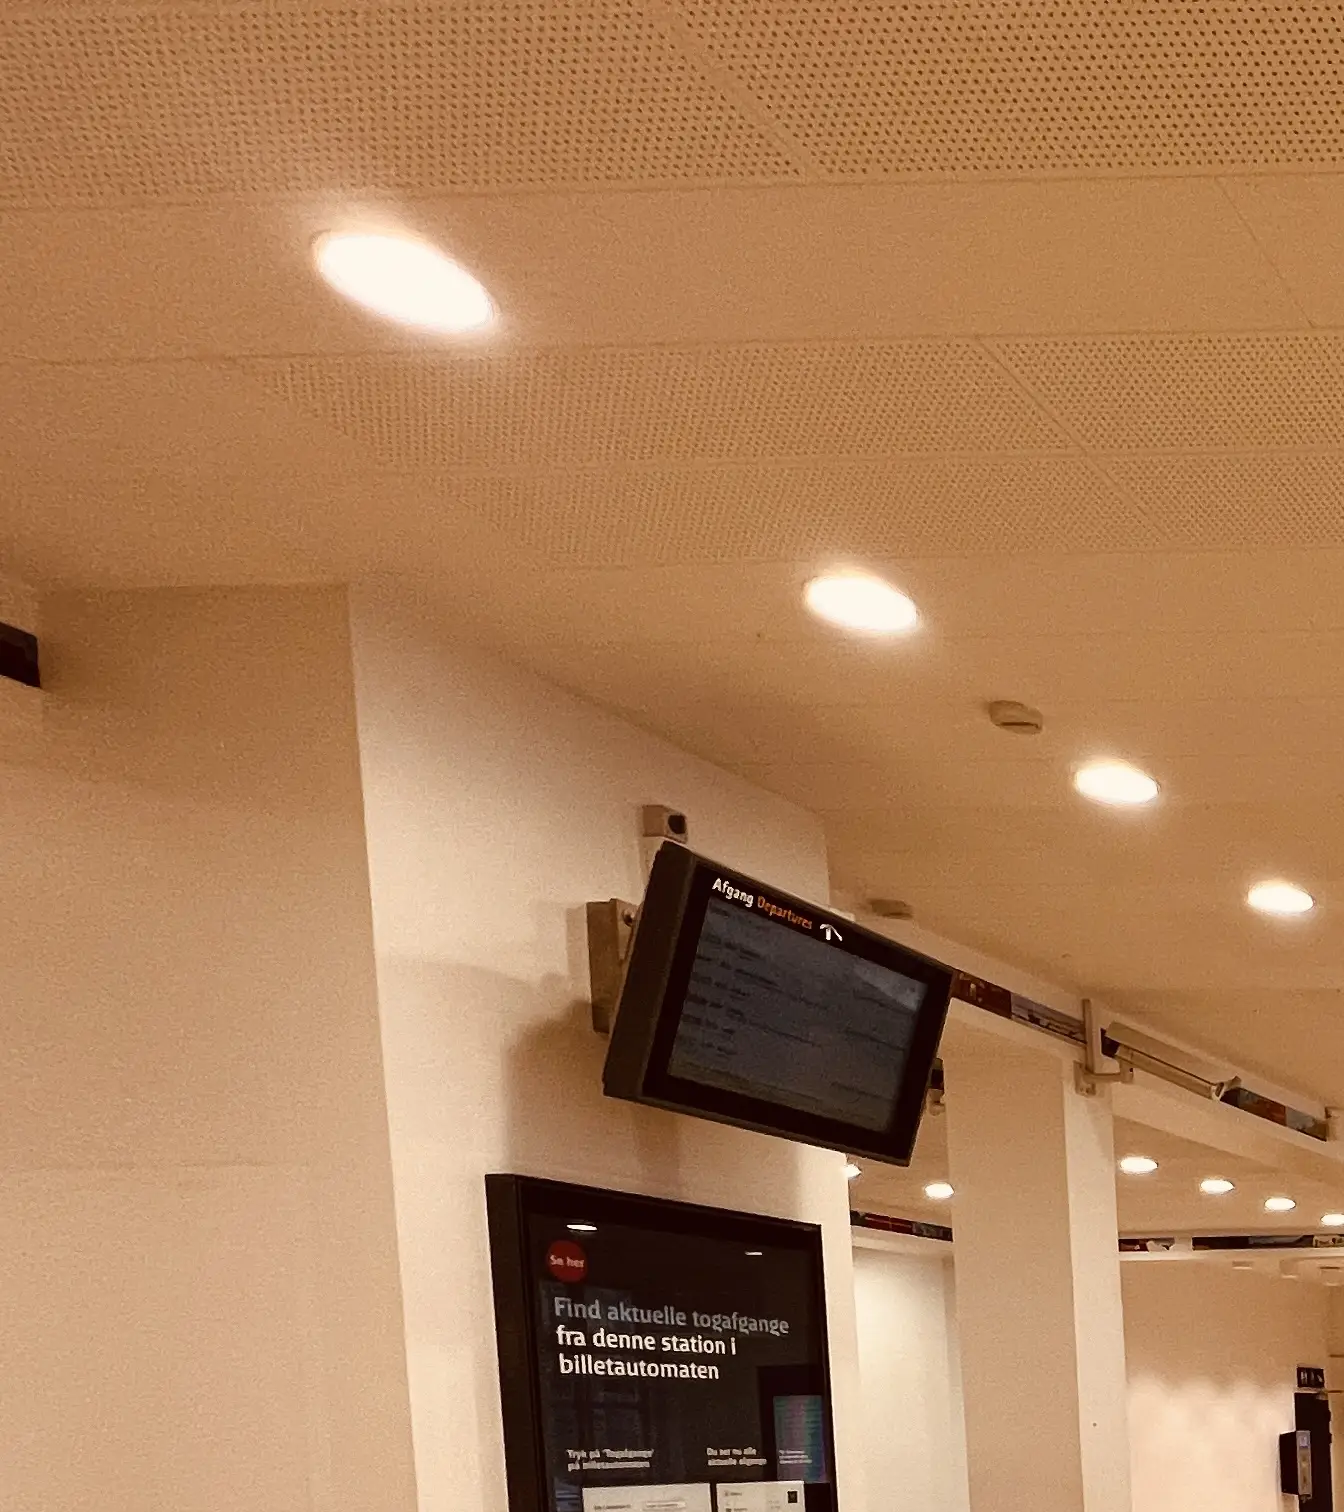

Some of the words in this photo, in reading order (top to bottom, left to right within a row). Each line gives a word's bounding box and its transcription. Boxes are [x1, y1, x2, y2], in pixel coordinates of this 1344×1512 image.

[711, 877, 754, 908] Afgang
[757, 895, 813, 930] Departures
[554, 1296, 601, 1320] Find
[607, 1301, 687, 1326] aktuelle
[692, 1311, 790, 1336] togafgange
[556, 1325, 587, 1347] fra
[592, 1327, 656, 1351] denne
[661, 1335, 726, 1356] station
[731, 1336, 737, 1356] i
[558, 1353, 720, 1380] billetautomaten
